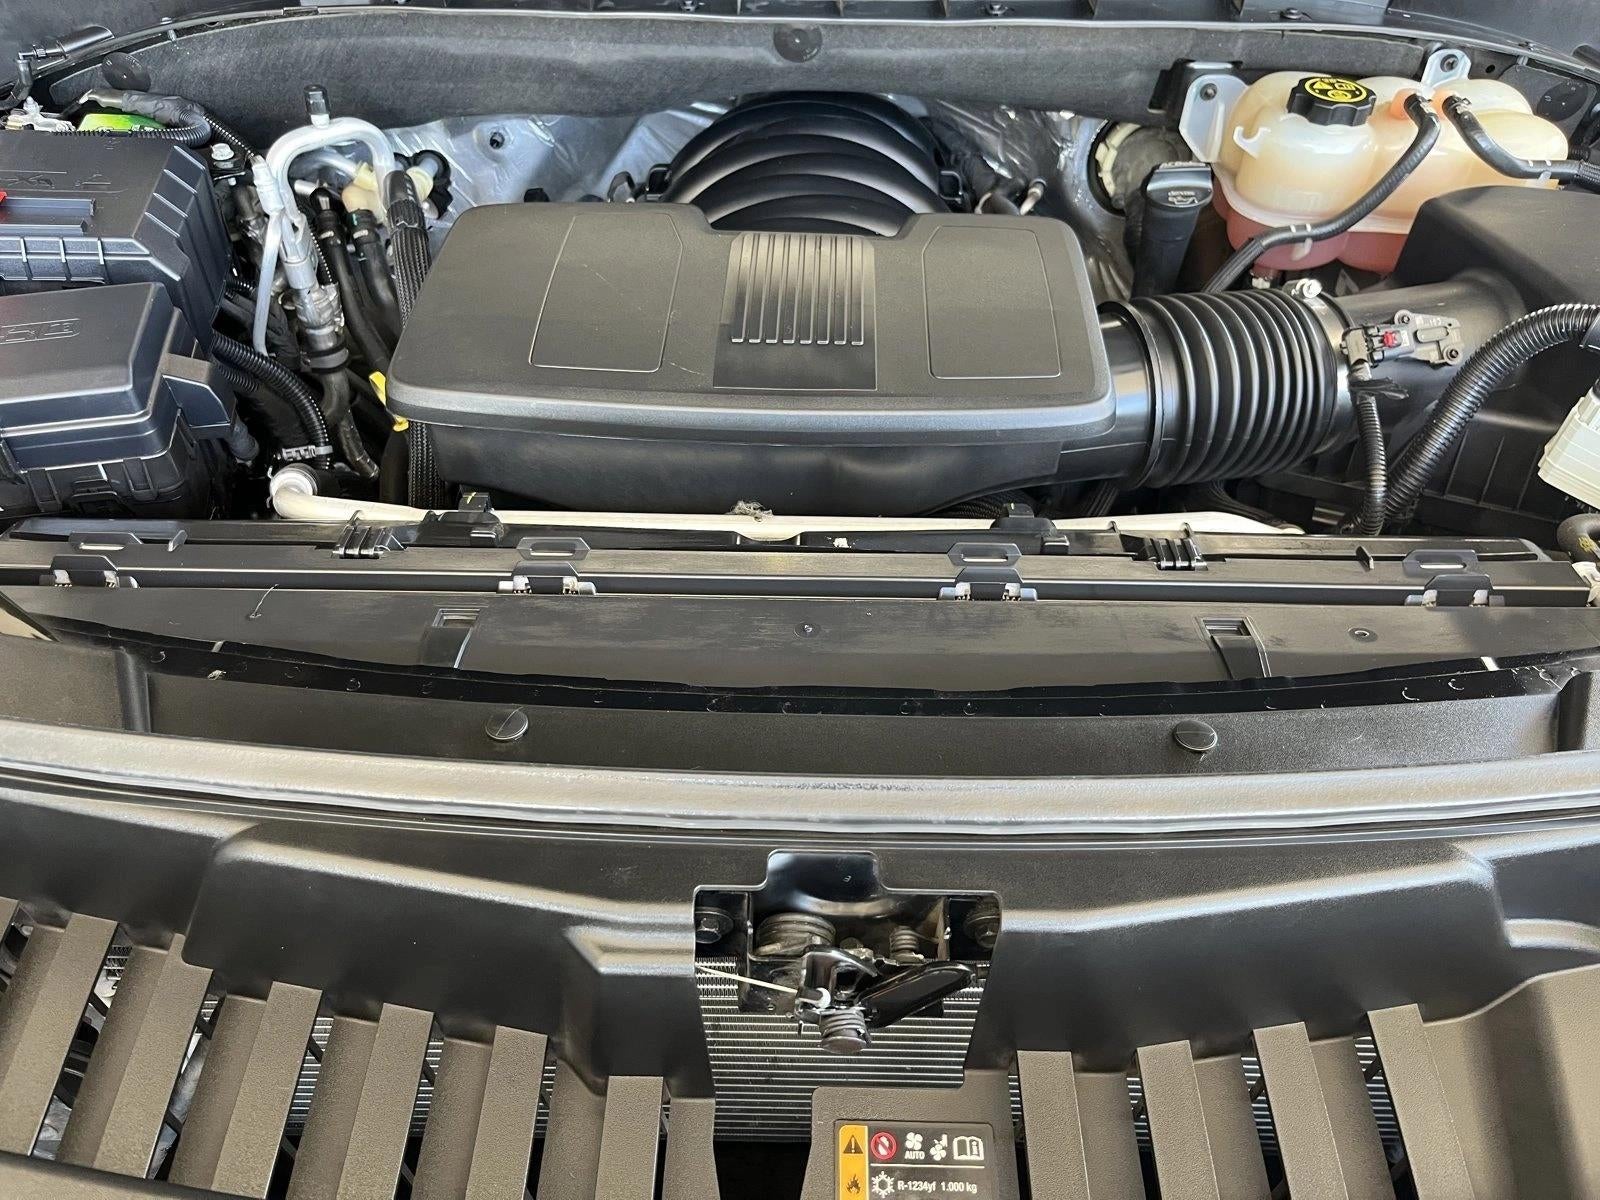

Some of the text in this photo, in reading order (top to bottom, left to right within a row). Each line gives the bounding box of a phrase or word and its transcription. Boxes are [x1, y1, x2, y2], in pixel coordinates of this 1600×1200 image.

[904, 1150, 925, 1160] AUTO
[897, 1180, 978, 1194] R-1234yf 1.000 kg
